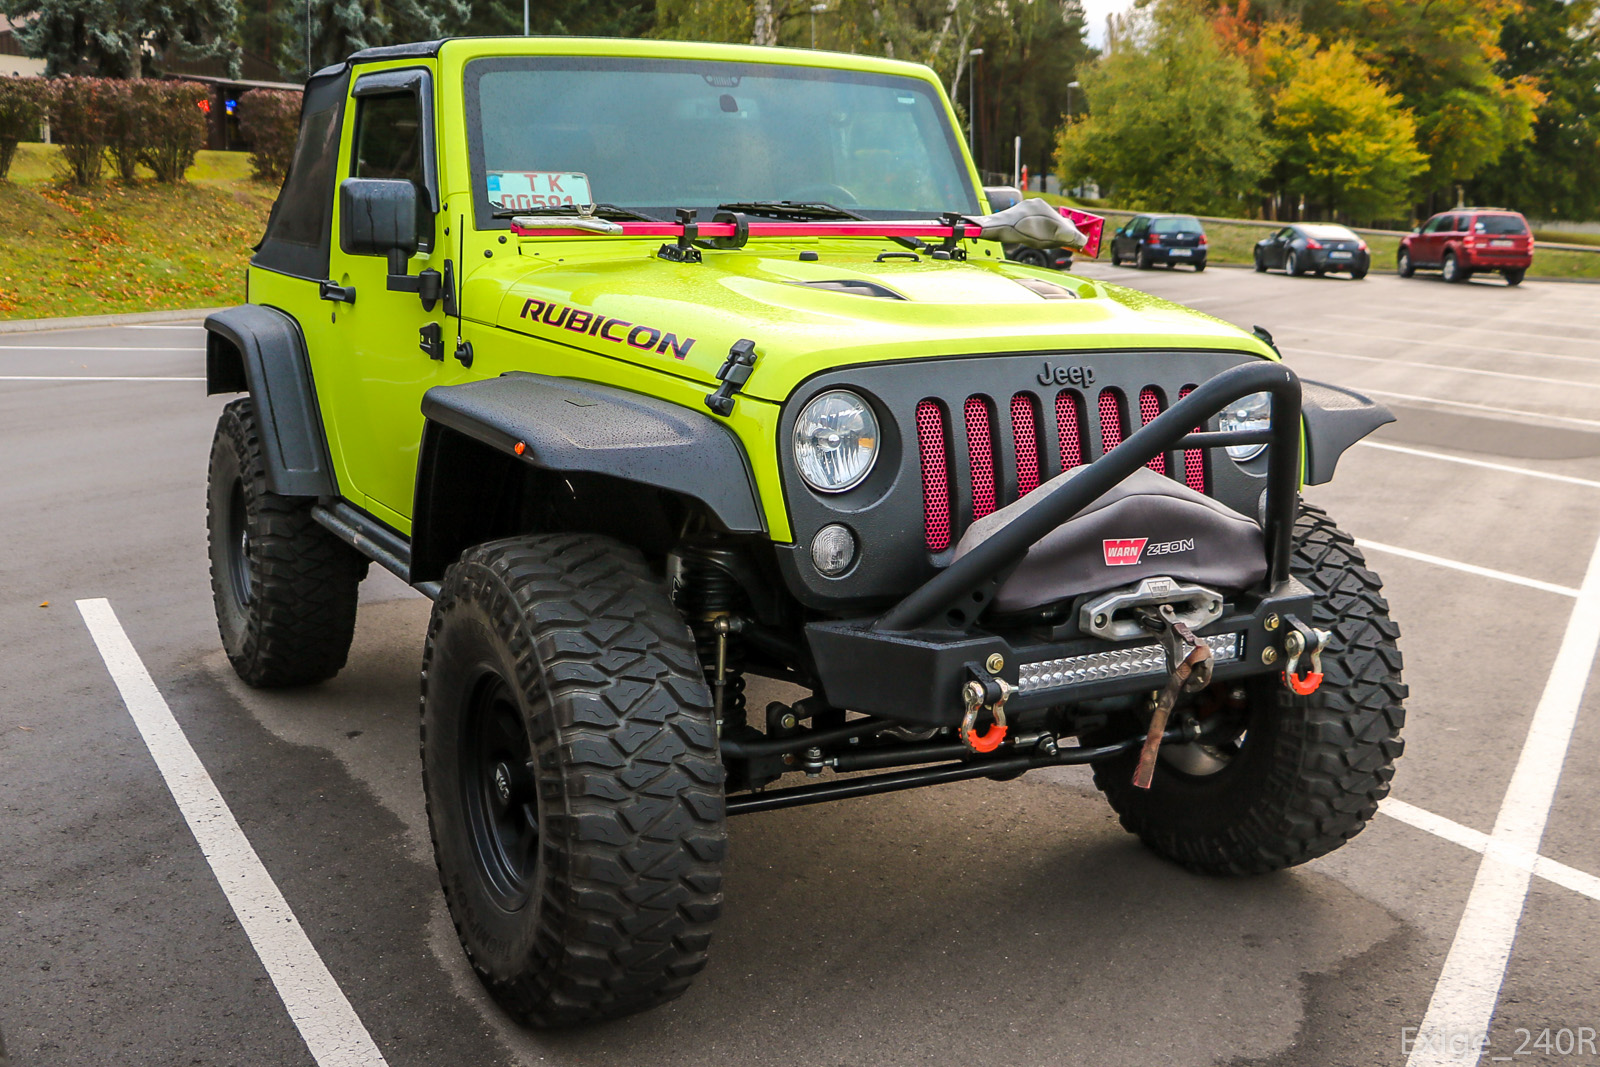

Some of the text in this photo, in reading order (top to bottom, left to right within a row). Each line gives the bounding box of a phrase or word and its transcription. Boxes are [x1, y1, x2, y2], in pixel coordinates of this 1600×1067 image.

[520, 298, 696, 360] RUBICON
[1037, 362, 1096, 388] Jeep
[1108, 538, 1195, 558] WARN ZEON
